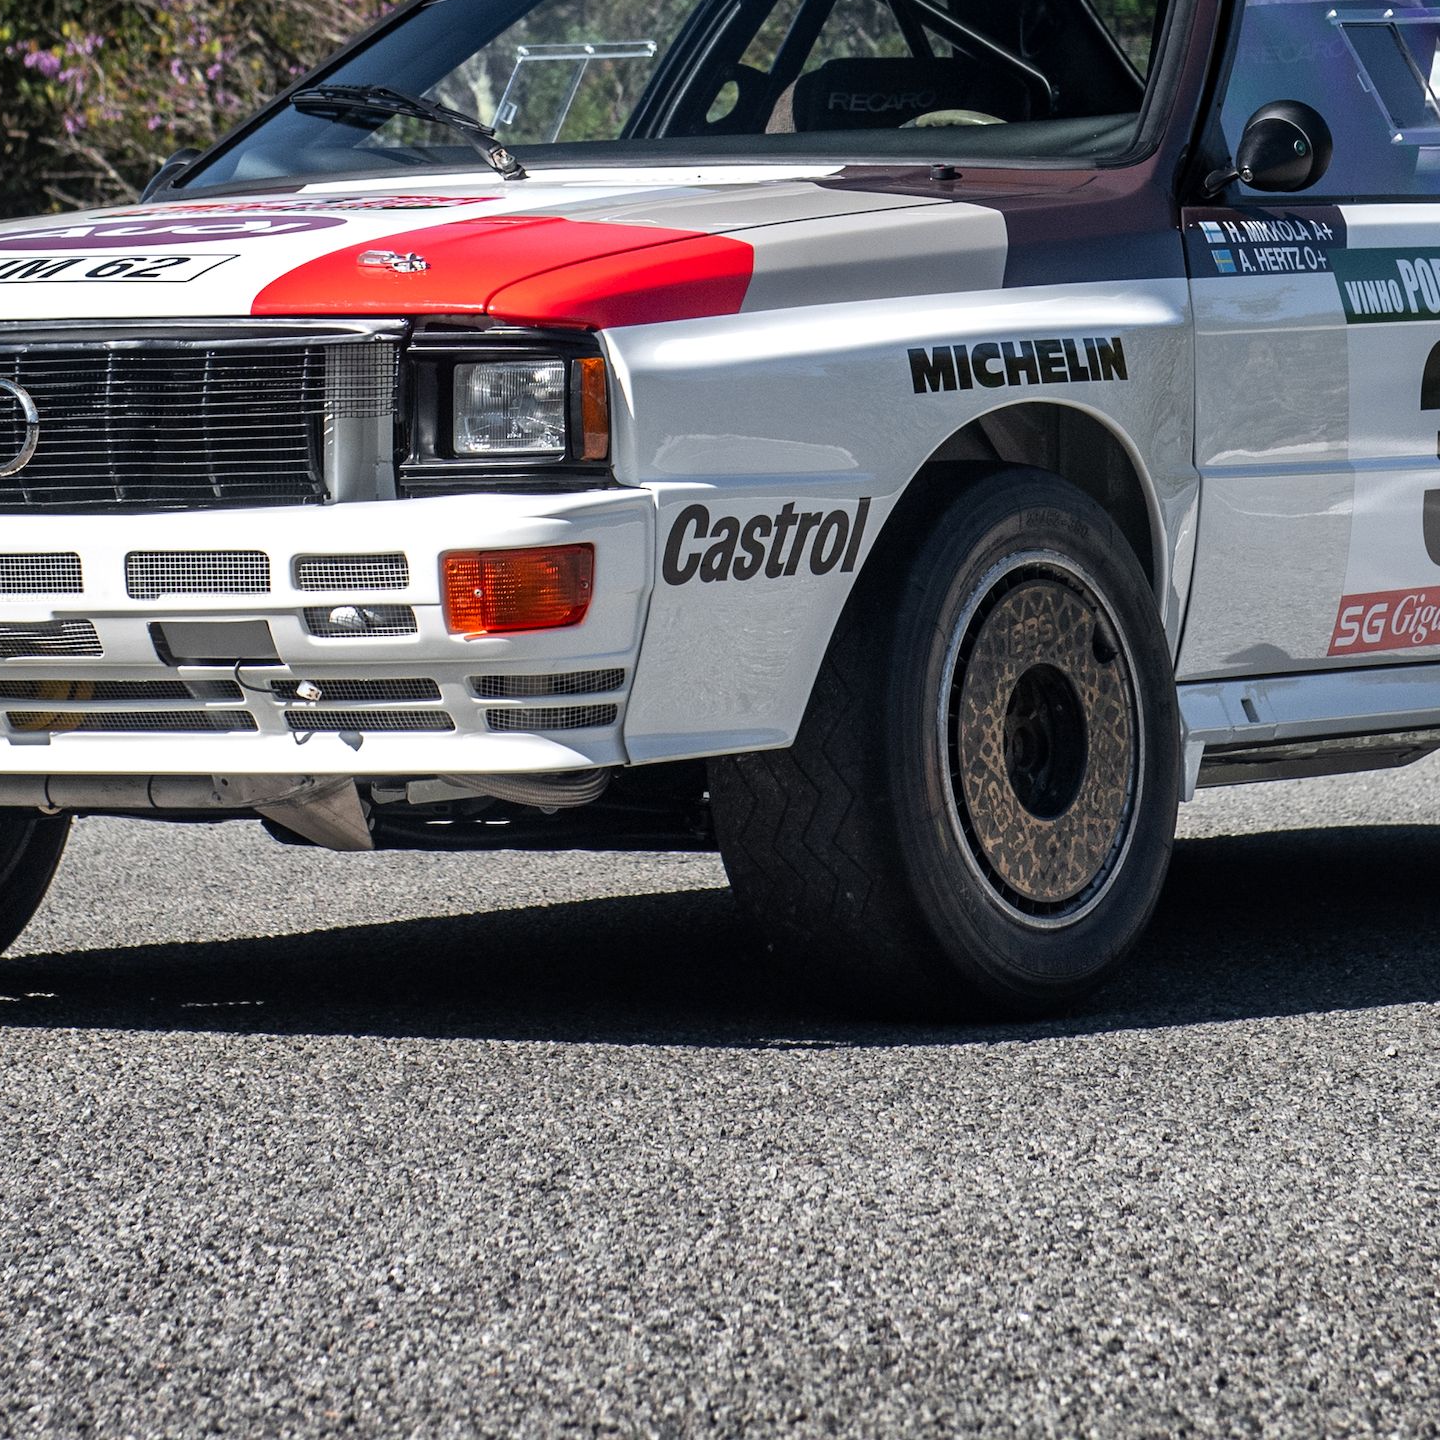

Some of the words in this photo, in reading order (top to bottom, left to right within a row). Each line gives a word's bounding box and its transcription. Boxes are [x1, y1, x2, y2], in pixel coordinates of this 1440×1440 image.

[828, 91, 937, 112] RECARO
[1223, 221, 1246, 243] H.
[1240, 221, 1312, 242] MIKKOLA
[1309, 220, 1333, 241] A+
[83, 256, 190, 279] 62
[1238, 249, 1256, 273] A.
[1253, 246, 1305, 272] HERTZ
[1344, 279, 1404, 315] VINHO
[907, 337, 1129, 394] MICHELIN
[662, 497, 872, 586] Castrol
[1334, 603, 1388, 647] SG
